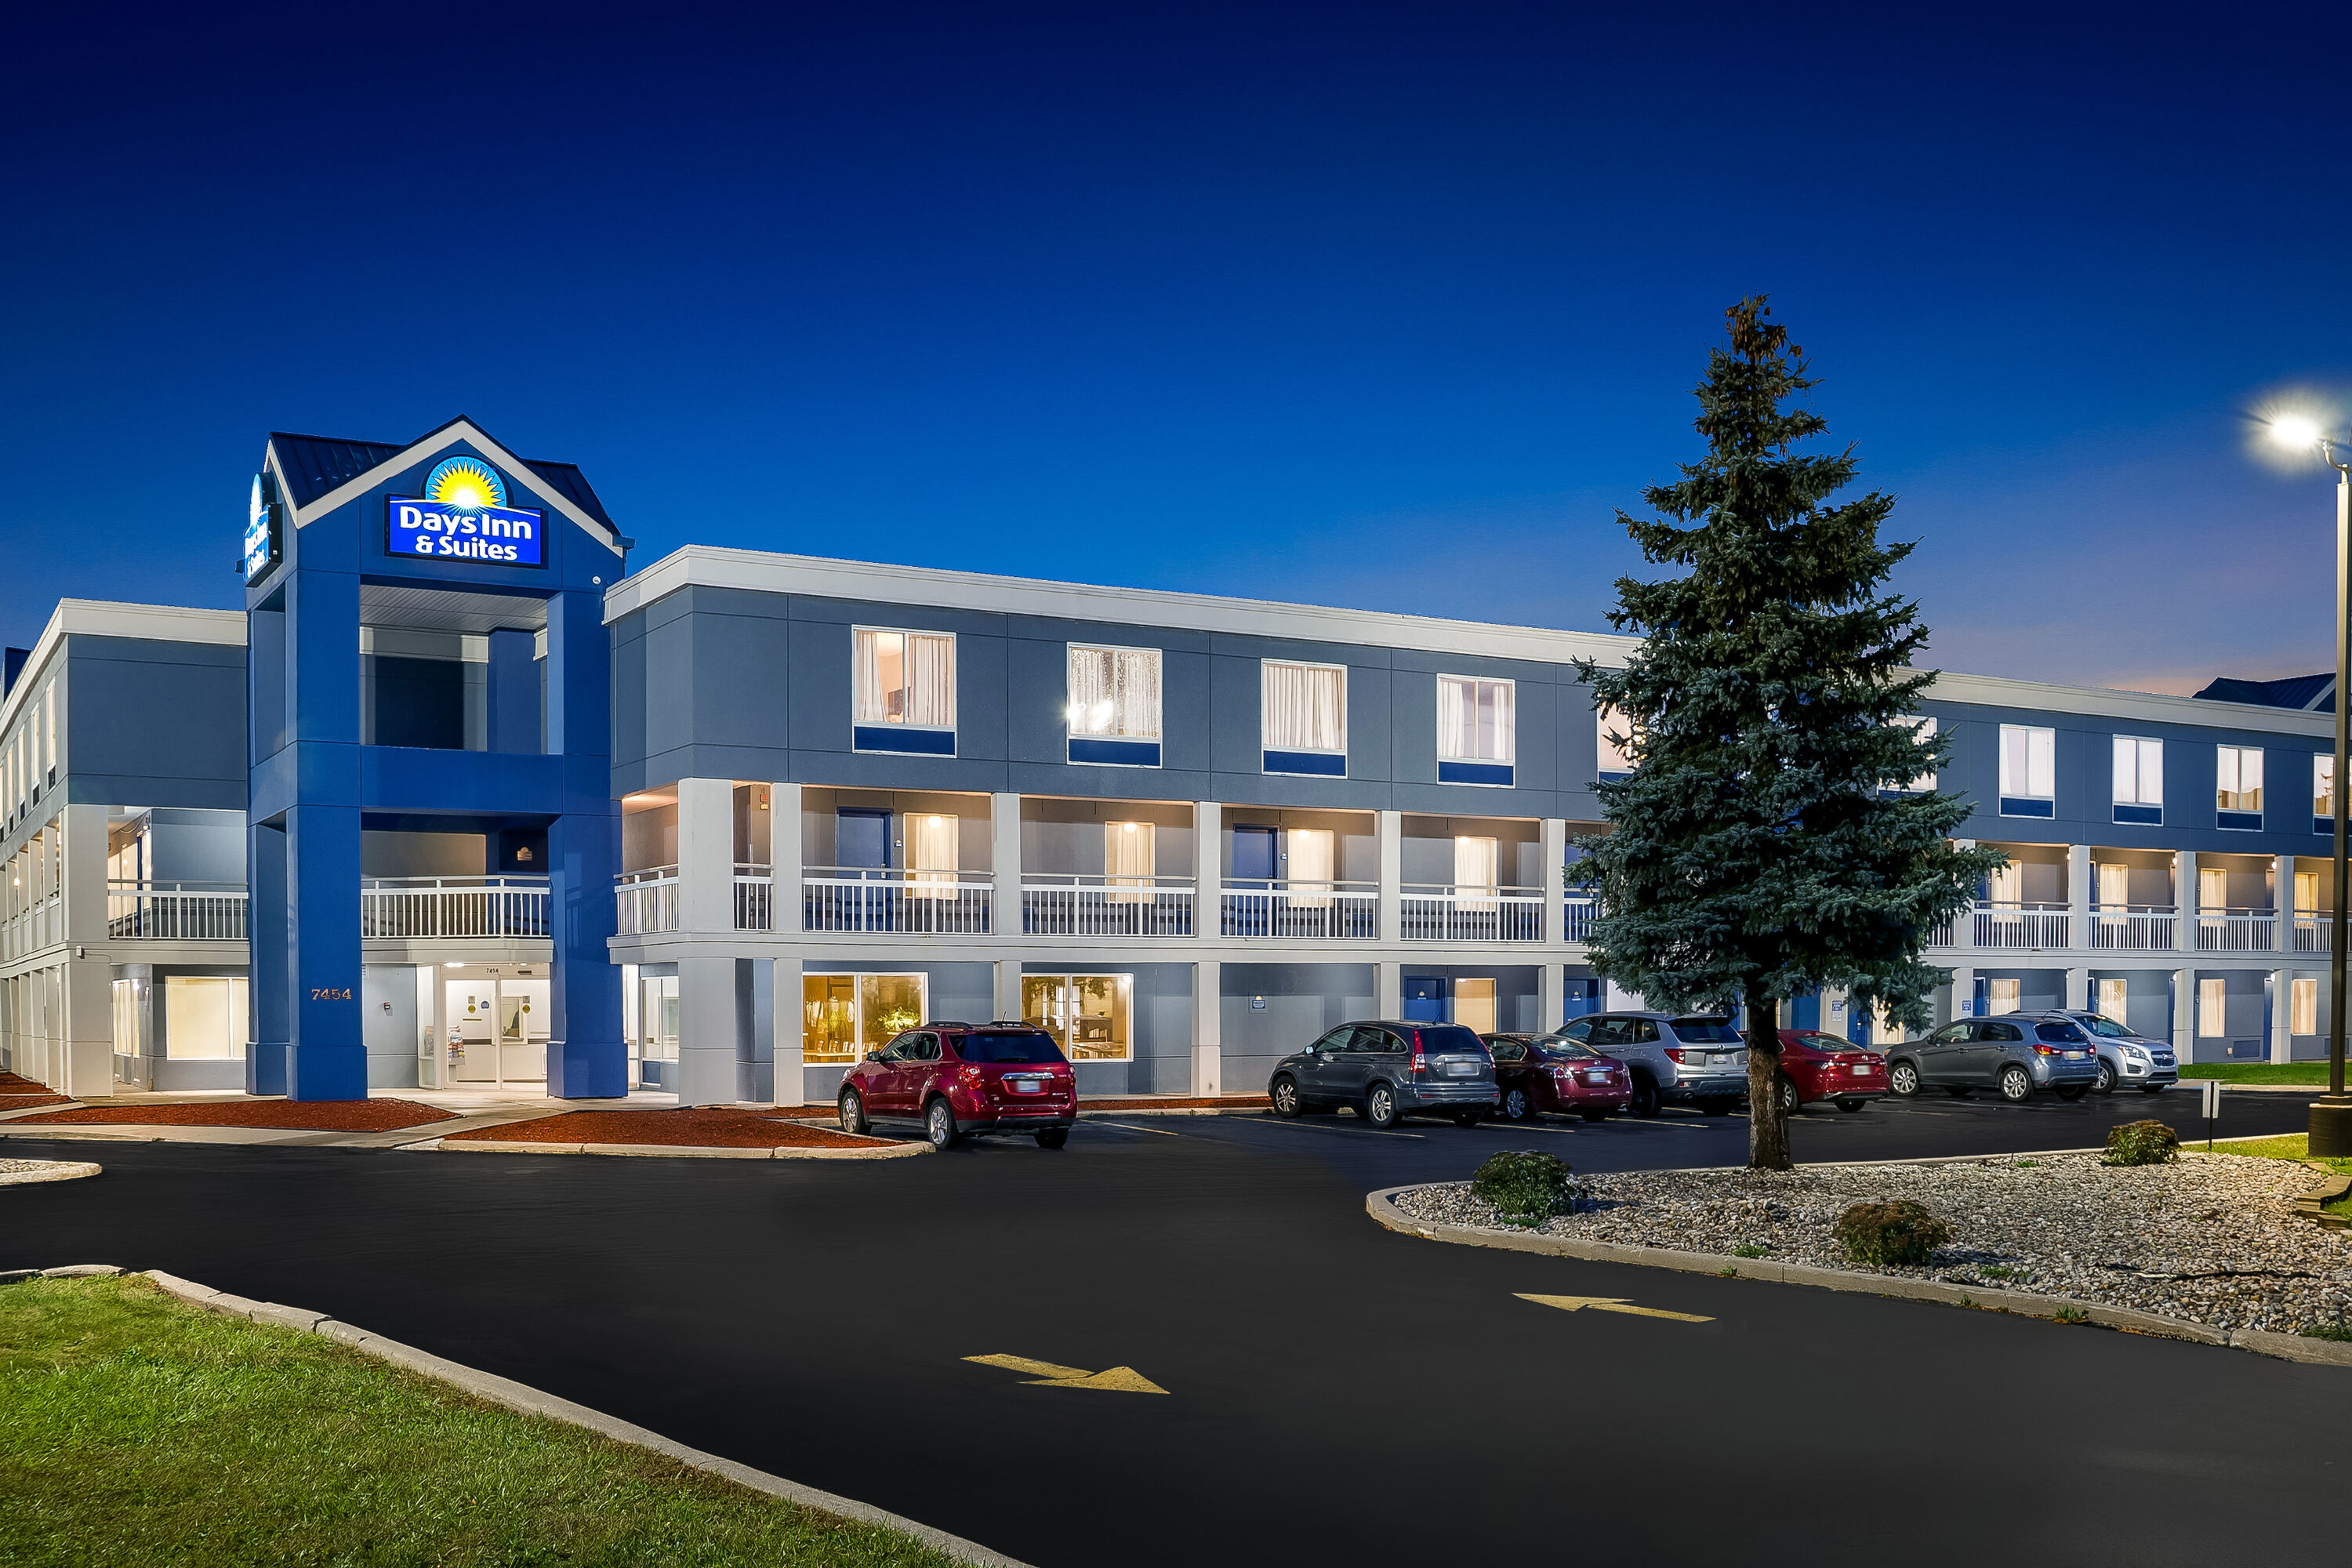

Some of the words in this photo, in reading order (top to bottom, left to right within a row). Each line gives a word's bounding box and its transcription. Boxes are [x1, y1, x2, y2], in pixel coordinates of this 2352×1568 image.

[400, 506, 477, 535] Days
[481, 514, 532, 539] Inn
[415, 535, 434, 554] &
[438, 535, 517, 561] Suites
[310, 988, 352, 1000] 7454
